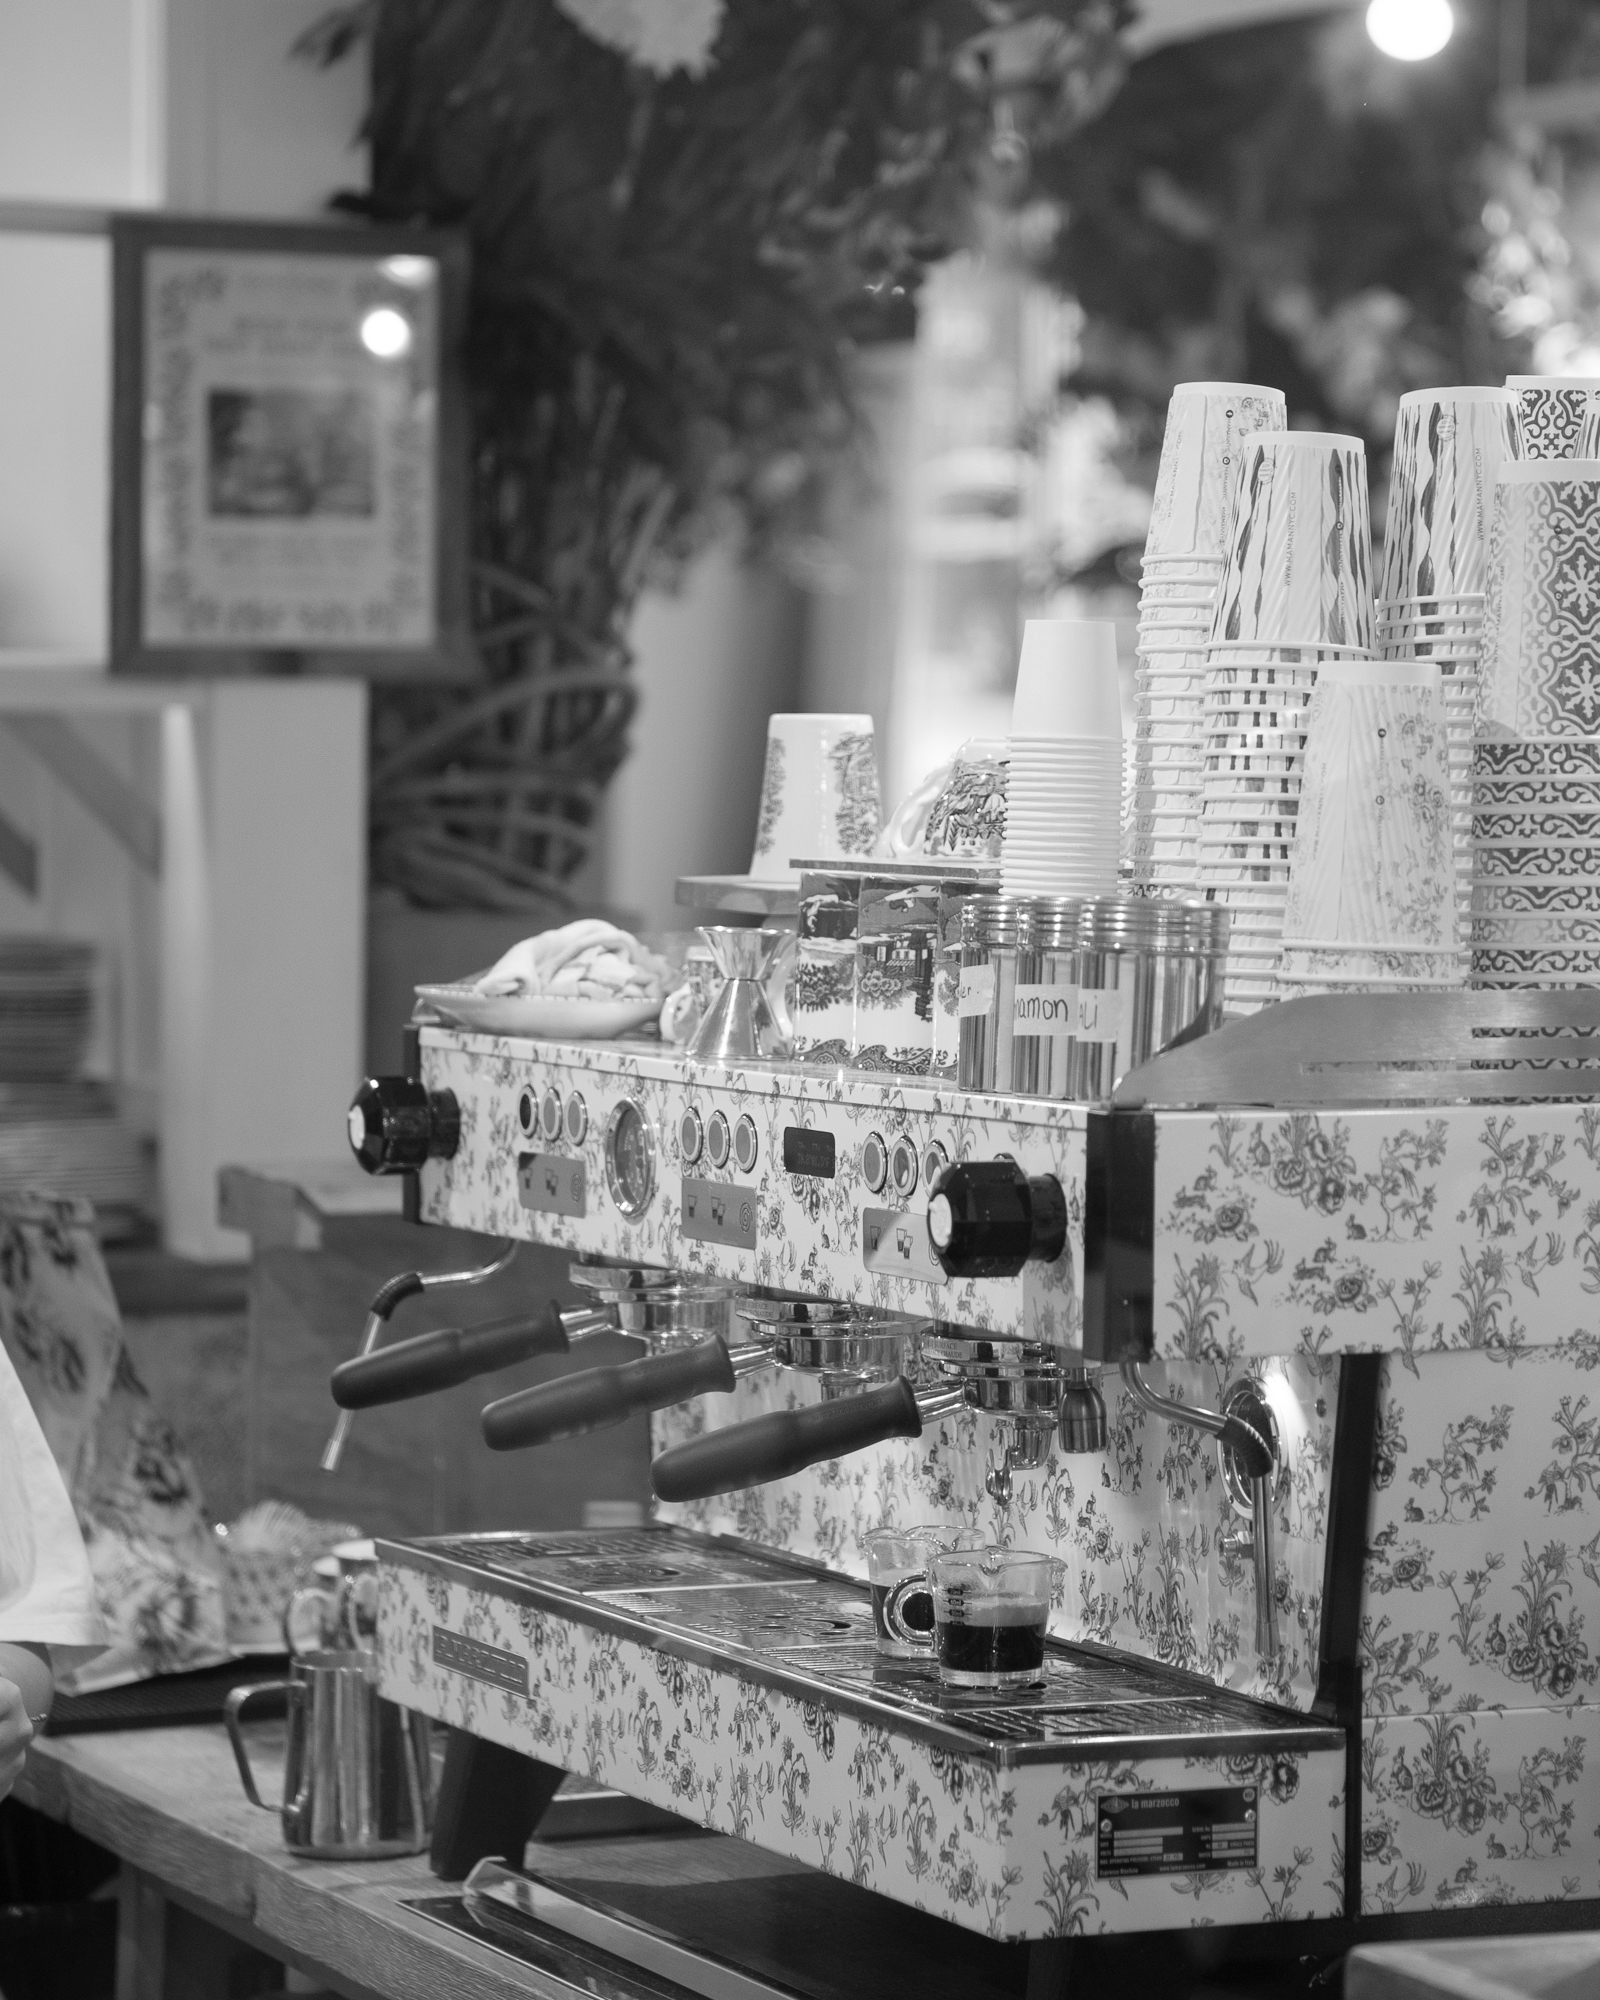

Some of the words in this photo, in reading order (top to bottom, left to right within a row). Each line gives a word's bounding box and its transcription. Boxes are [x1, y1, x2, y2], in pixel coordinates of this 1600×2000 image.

[1284, 492, 1297, 587] WWW.MAMANNYC.COM
[1475, 447, 1484, 540] WWW.MAMANNYC.COM
[1131, 1798, 1139, 1809] la
[1141, 1797, 1180, 1809] marzocco
